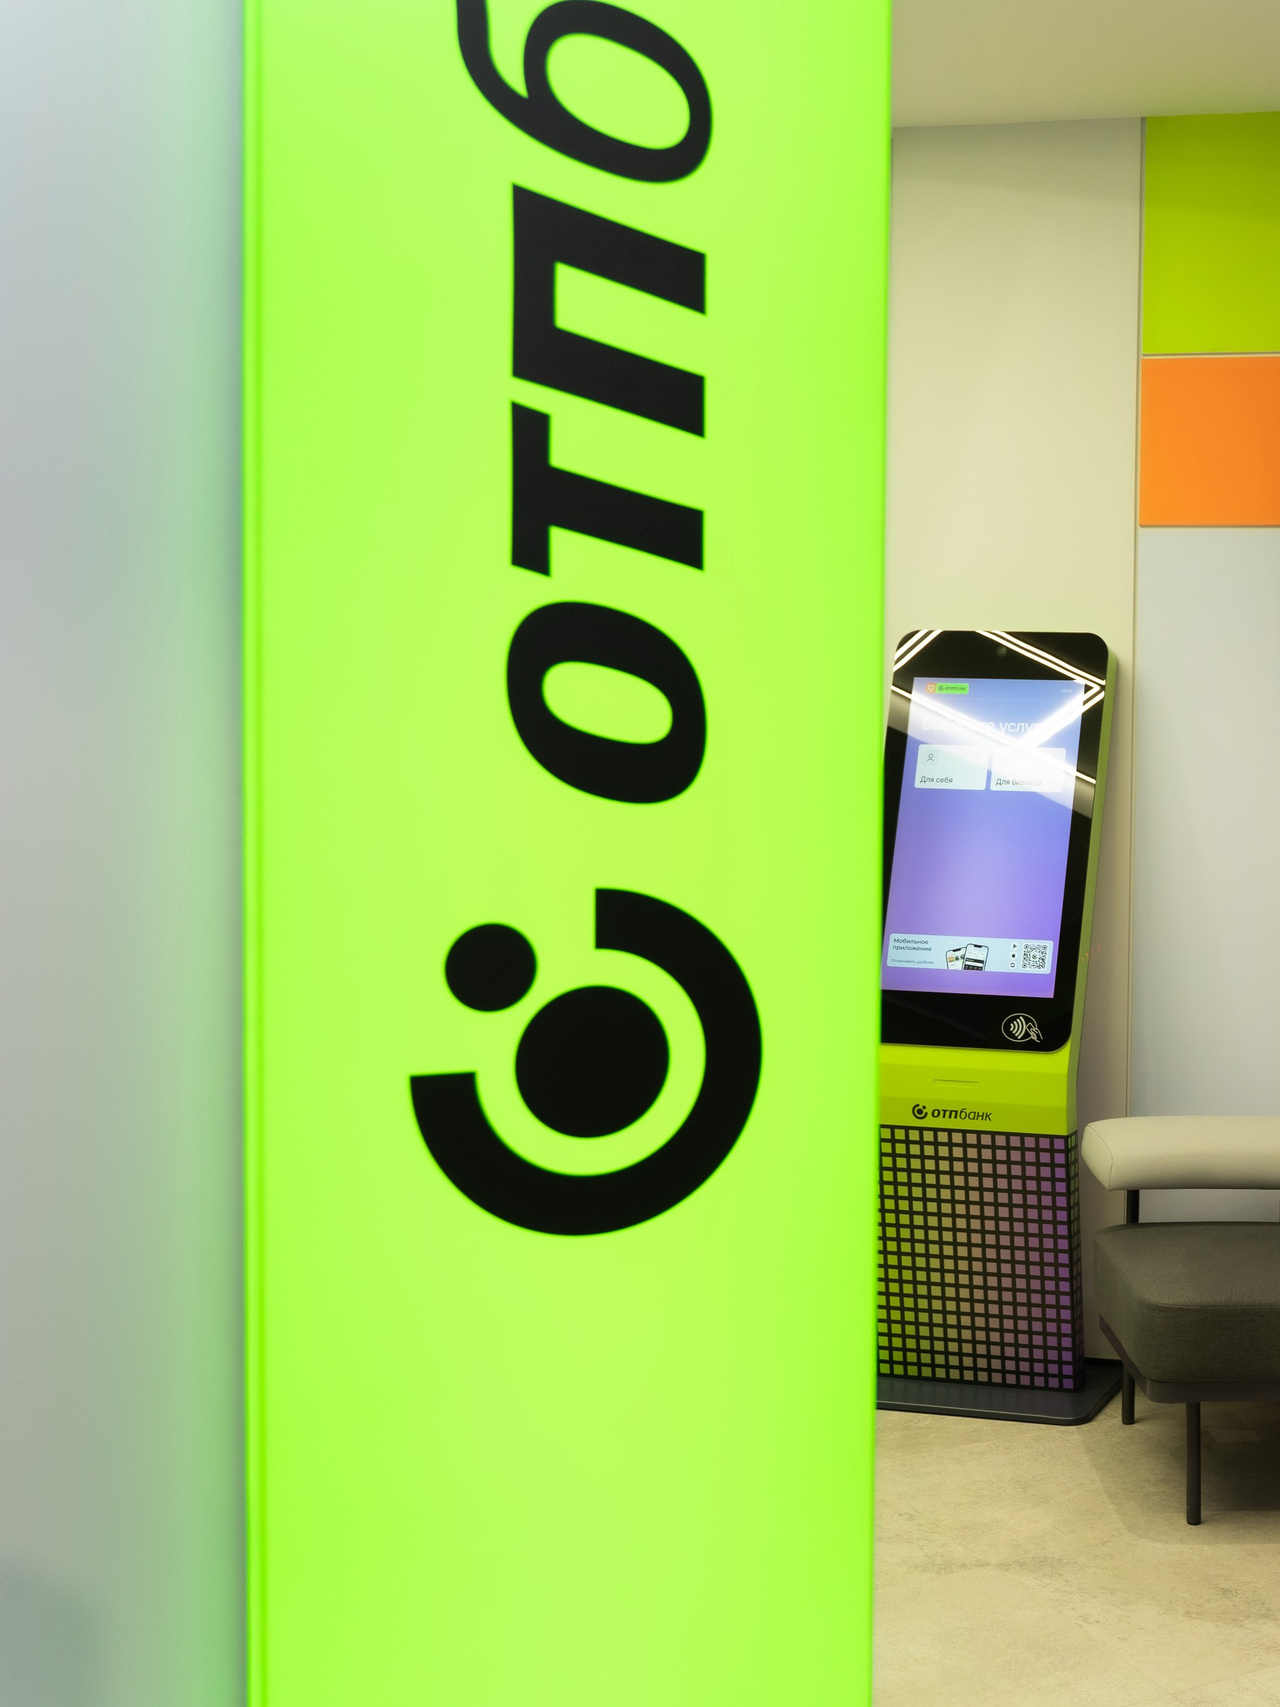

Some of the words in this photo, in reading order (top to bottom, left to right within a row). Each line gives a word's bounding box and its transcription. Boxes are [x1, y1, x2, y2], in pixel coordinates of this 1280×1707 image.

[920, 776, 935, 784] Для
[936, 776, 953, 784] себя
[995, 778, 1010, 786] Для
[893, 937, 929, 945] Мобильное
[892, 944, 932, 952] приложение
[931, 1107, 992, 1122] отпбанк
